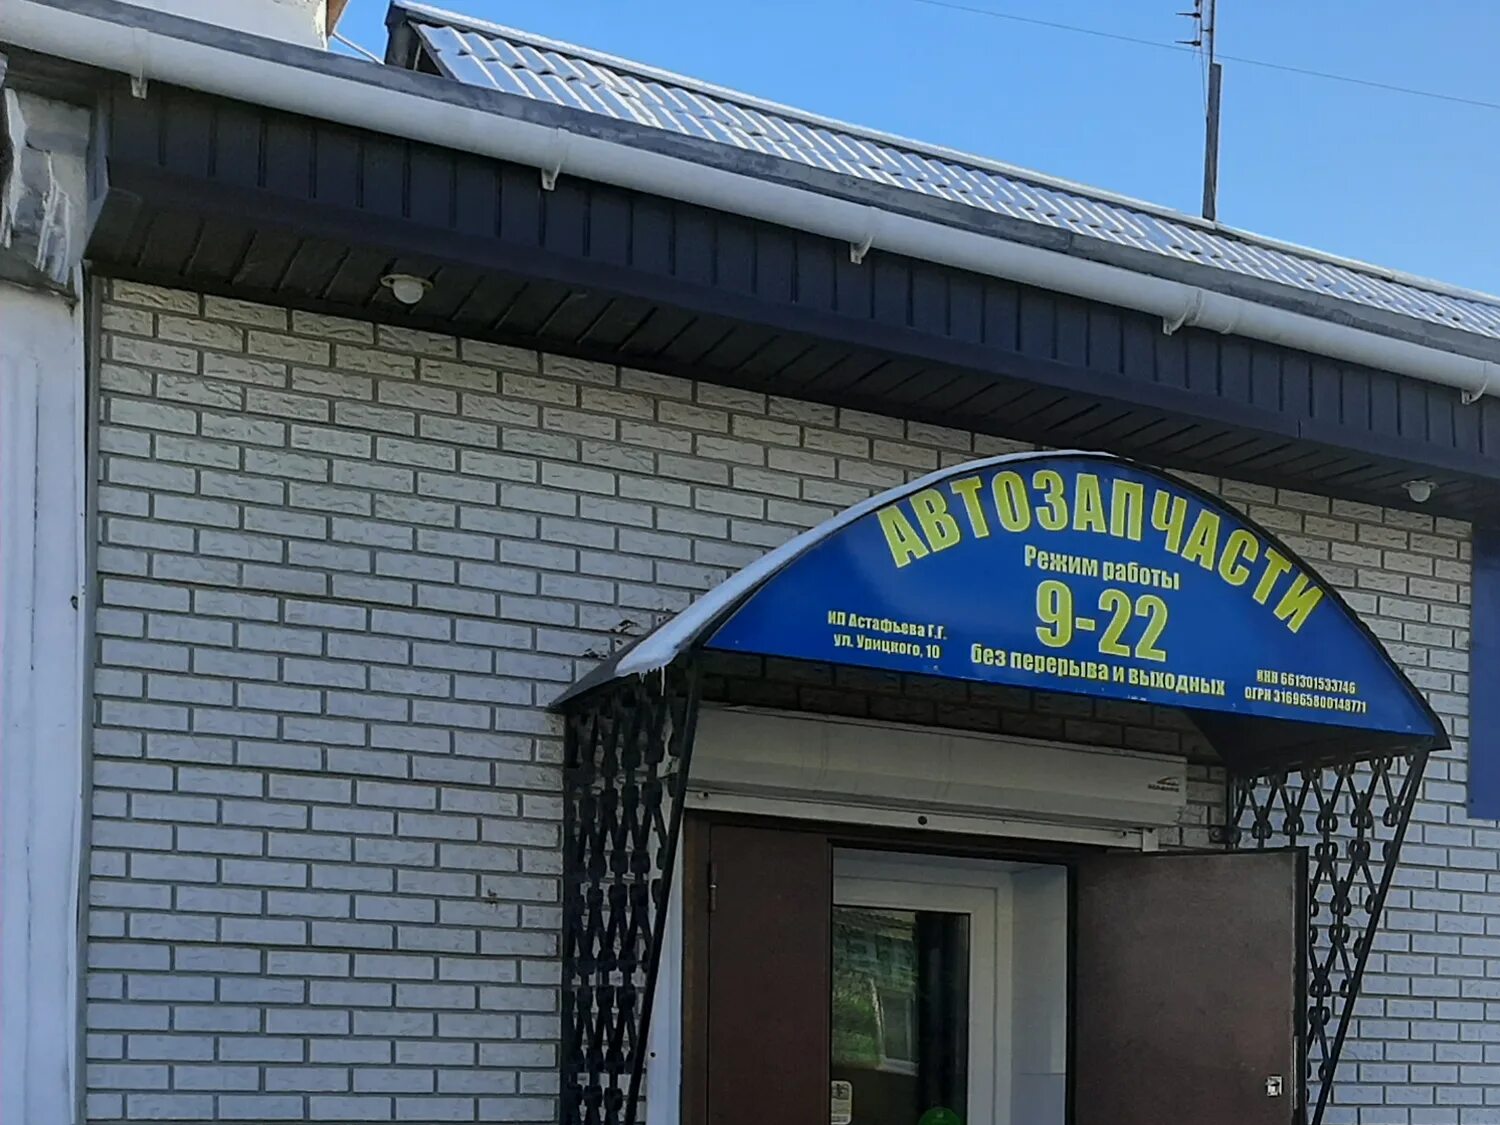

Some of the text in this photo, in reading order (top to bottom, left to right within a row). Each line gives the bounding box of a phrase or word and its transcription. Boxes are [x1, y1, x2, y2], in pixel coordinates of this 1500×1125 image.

[876, 469, 1325, 633] АВТОЗАПЧАСТИ
[1024, 545, 1180, 590] Режим работы
[827, 610, 846, 626] ИП
[848, 613, 926, 637] Астафьева
[1035, 579, 1168, 662] 9-22
[833, 633, 940, 659] ул. Урицкого, 10
[970, 643, 1226, 696] без перерыва и выходных
[1280, 672, 1356, 694] 661301533746
[1244, 686, 1272, 701] ОГРН
